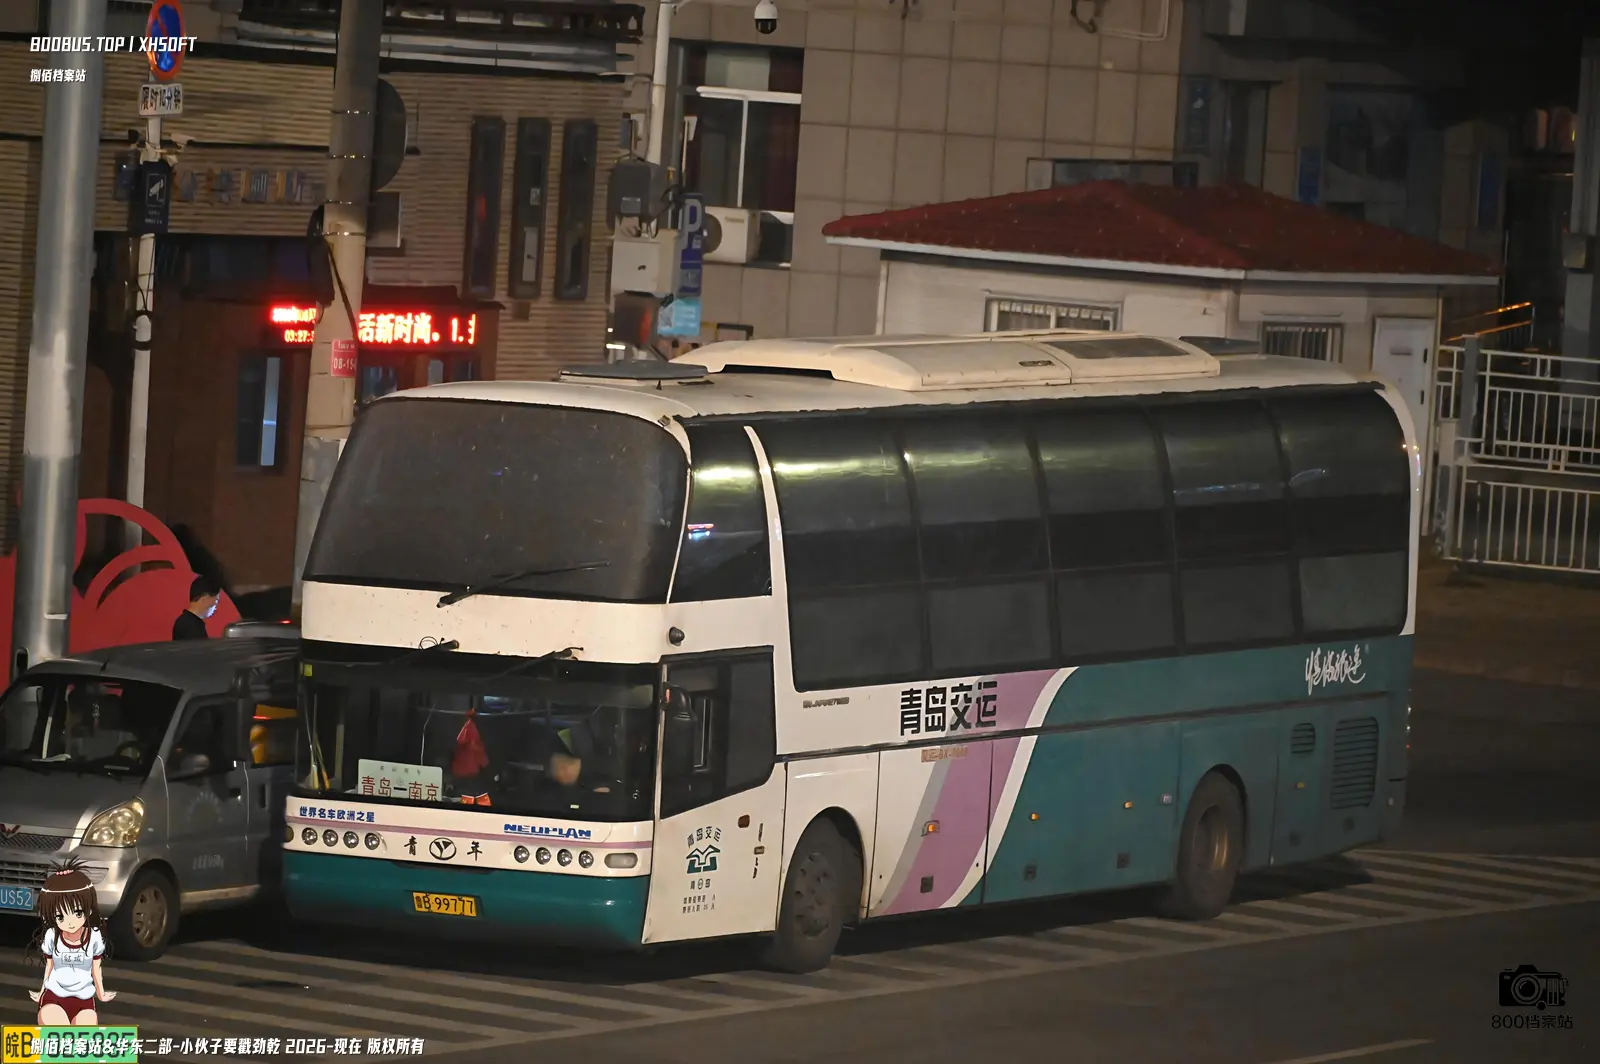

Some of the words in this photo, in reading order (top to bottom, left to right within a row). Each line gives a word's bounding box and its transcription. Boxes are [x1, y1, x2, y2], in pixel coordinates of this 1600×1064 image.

[900, 681, 998, 736] 青岛交运
[300, 806, 375, 823] 世界名车欧洲之星
